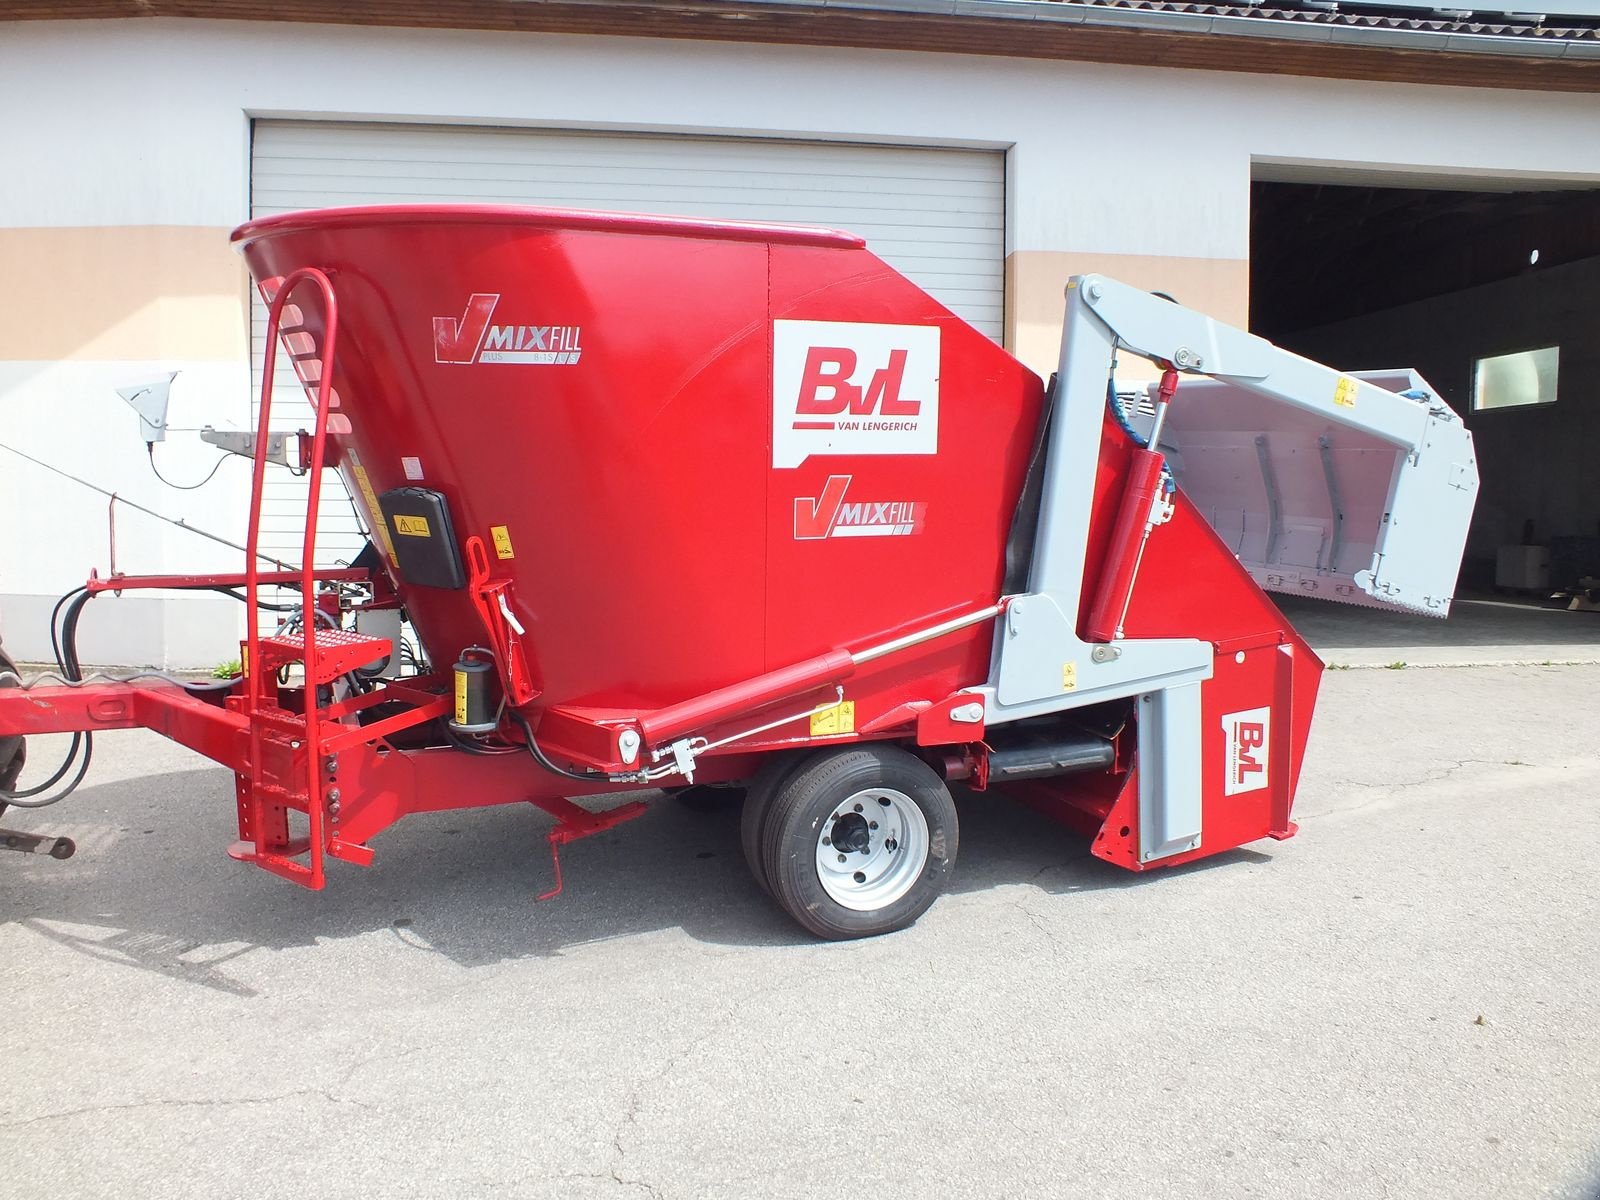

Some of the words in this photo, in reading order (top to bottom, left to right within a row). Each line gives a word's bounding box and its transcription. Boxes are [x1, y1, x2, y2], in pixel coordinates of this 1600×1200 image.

[482, 352, 503, 362] PLUS
[837, 421, 860, 431] VAN
[862, 421, 918, 432] LENGERICH
